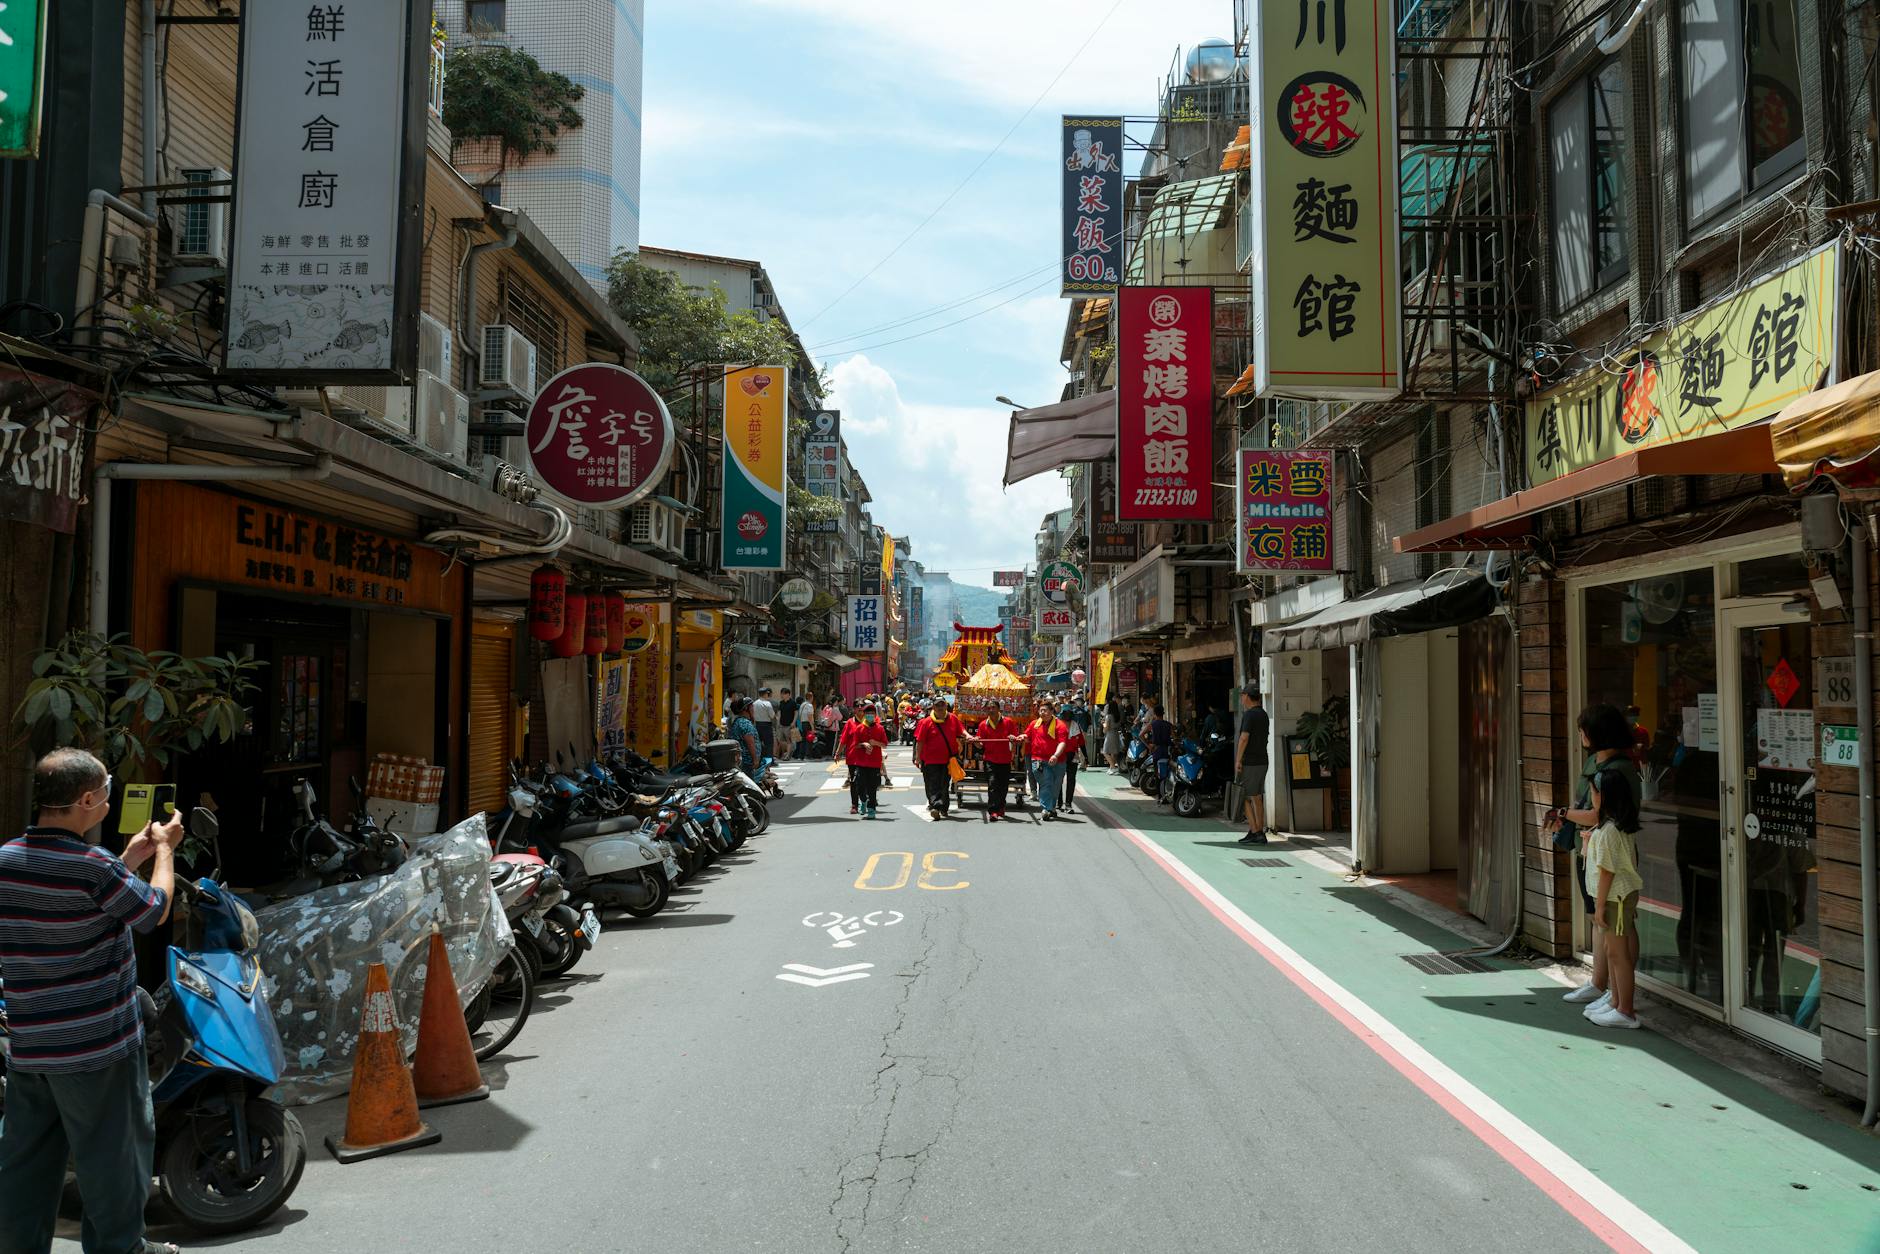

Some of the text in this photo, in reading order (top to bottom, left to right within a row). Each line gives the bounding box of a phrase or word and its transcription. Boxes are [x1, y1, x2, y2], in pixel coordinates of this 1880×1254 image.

[298, 5, 345, 209] 鮮活倉廚
[1066, 141, 1119, 172] 出外人
[1073, 175, 1112, 253] 菜飯
[261, 235, 370, 249] 海鮮 零售 批發
[260, 262, 369, 276] 本港 進口 活體
[747, 403, 762, 463] 公益彩券
[813, 412, 834, 436] 9
[1134, 488, 1198, 506] 2732-5180
[1249, 503, 1324, 517] Michelle
[854, 598, 878, 649] 招牌
[1828, 676, 1851, 702] 88
[1838, 744, 1853, 760] 88
[854, 852, 970, 890] 30
